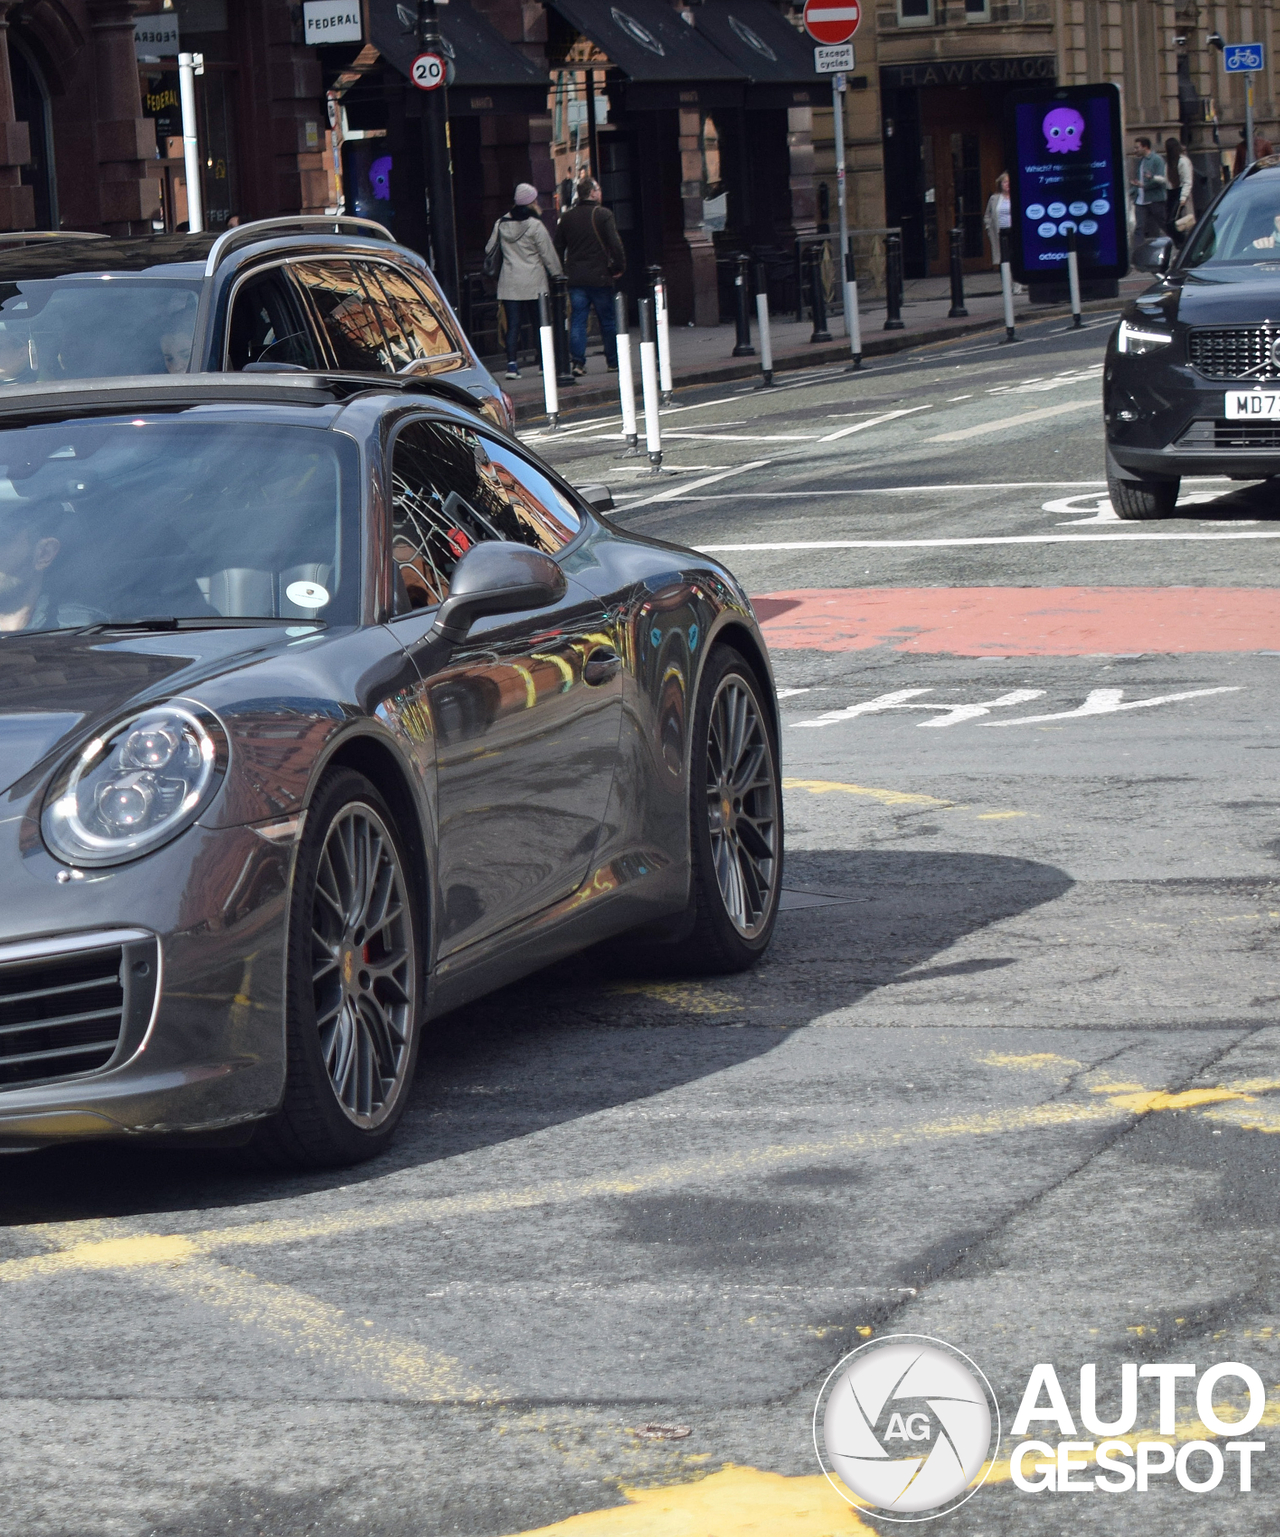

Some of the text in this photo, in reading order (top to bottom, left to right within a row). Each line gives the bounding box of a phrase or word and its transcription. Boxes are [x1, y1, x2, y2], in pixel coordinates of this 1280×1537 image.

[308, 14, 359, 30] FEDERAL
[818, 48, 851, 60] Except
[416, 63, 440, 79] 20
[820, 58, 849, 69] cycles
[147, 89, 177, 112] FEDERAL
[1039, 252, 1069, 261] octopu
[1237, 395, 1280, 414] MD7
